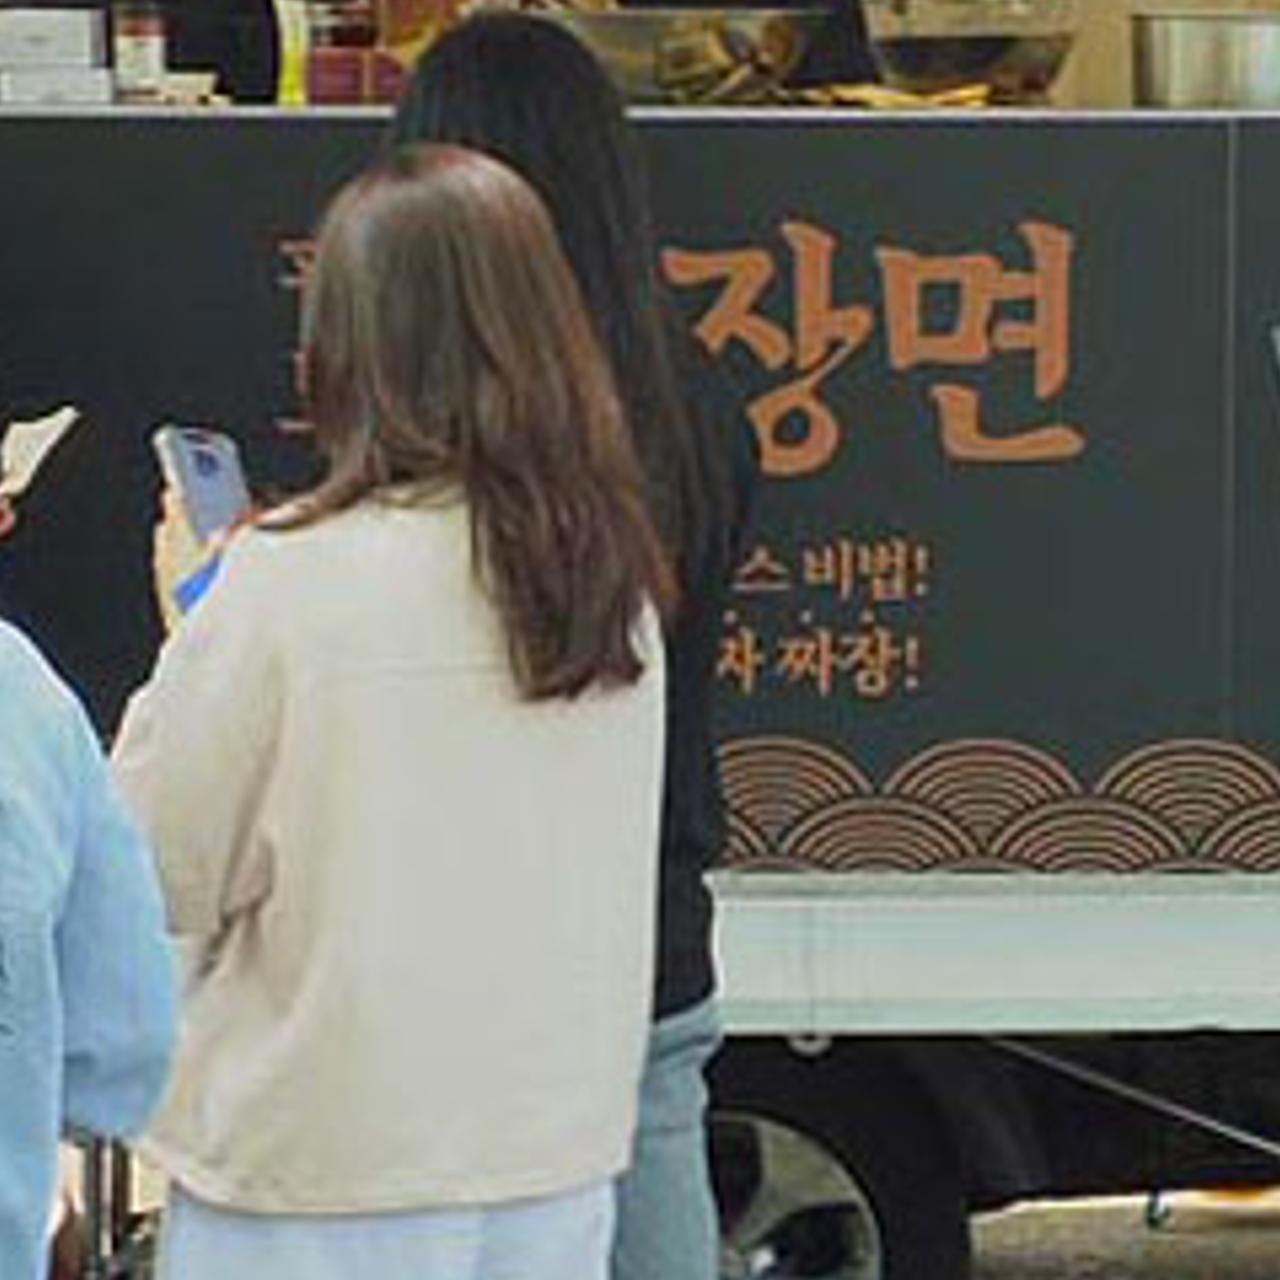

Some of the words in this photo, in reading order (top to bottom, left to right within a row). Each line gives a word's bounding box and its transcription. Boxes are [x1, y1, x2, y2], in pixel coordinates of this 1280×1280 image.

[660, 220, 1087, 478] 장면
[731, 544, 791, 592] 스
[802, 537, 928, 603] 비법!
[776, 625, 920, 697] 짜장!
